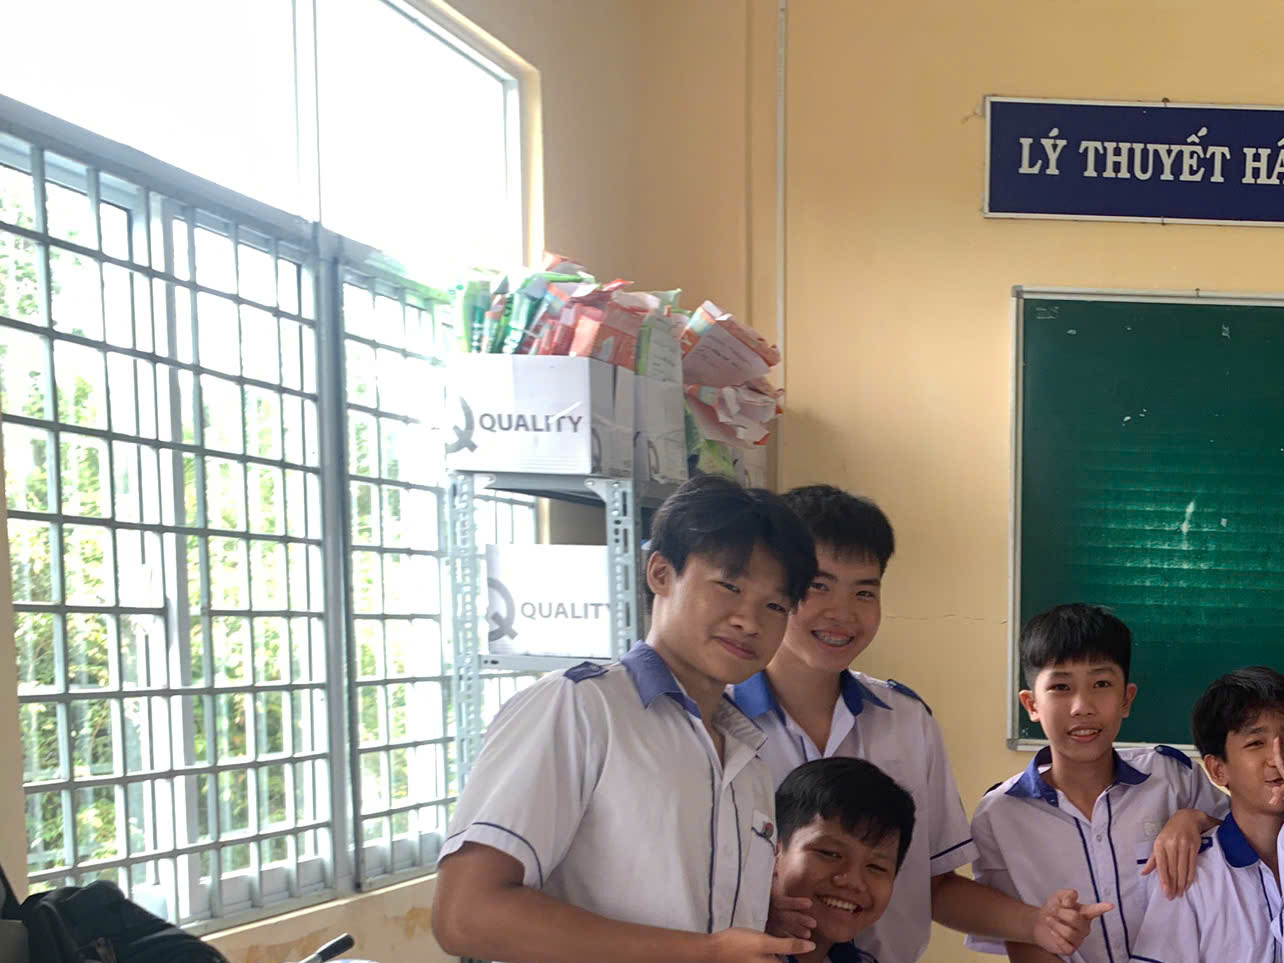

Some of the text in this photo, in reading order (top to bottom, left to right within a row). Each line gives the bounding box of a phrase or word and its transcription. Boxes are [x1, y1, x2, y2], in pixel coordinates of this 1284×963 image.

[1018, 127, 1067, 177] LÝ
[1078, 126, 1232, 183] THUYẾT
[520, 602, 611, 620] QUALIT
